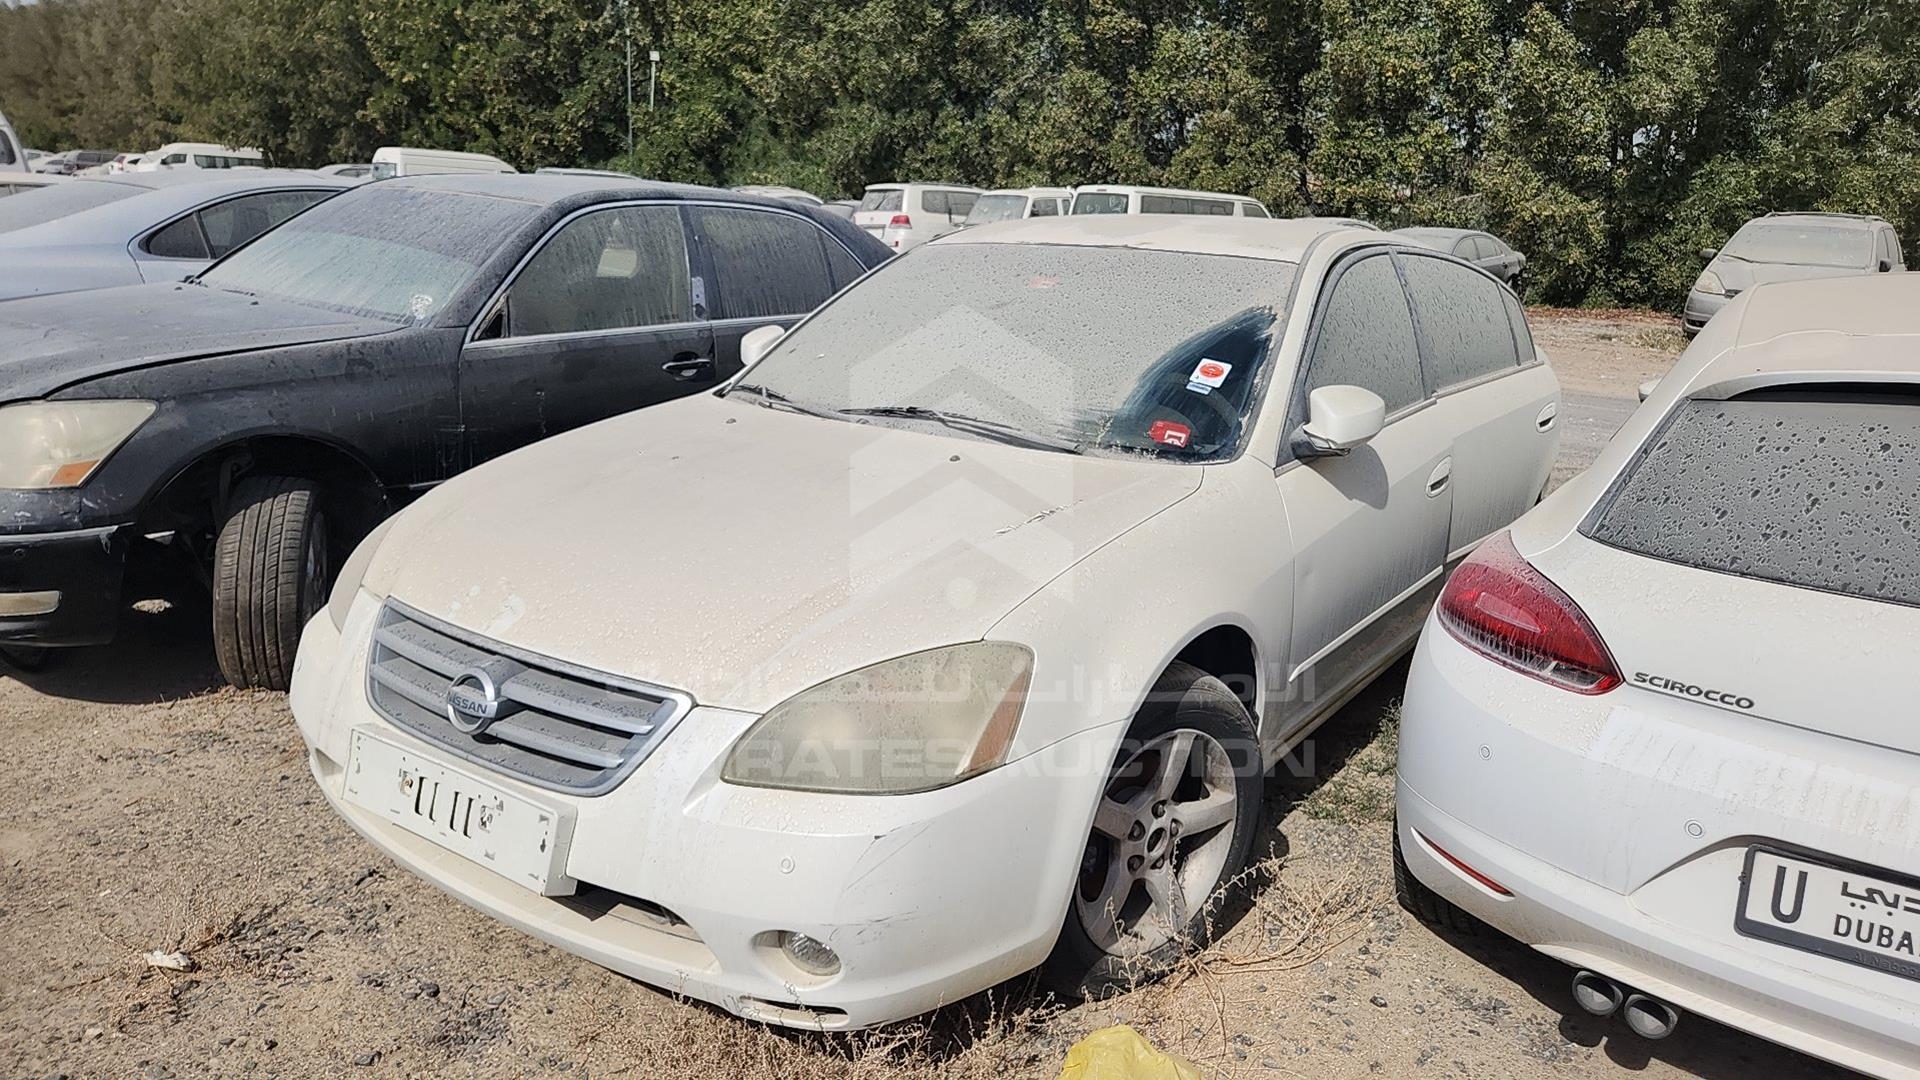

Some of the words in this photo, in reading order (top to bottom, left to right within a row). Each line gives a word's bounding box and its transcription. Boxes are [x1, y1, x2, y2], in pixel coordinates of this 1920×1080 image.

[1634, 672, 1754, 709] SCIROCCO
[1771, 865, 1808, 923] U
[1833, 914, 1920, 955] DUBA
